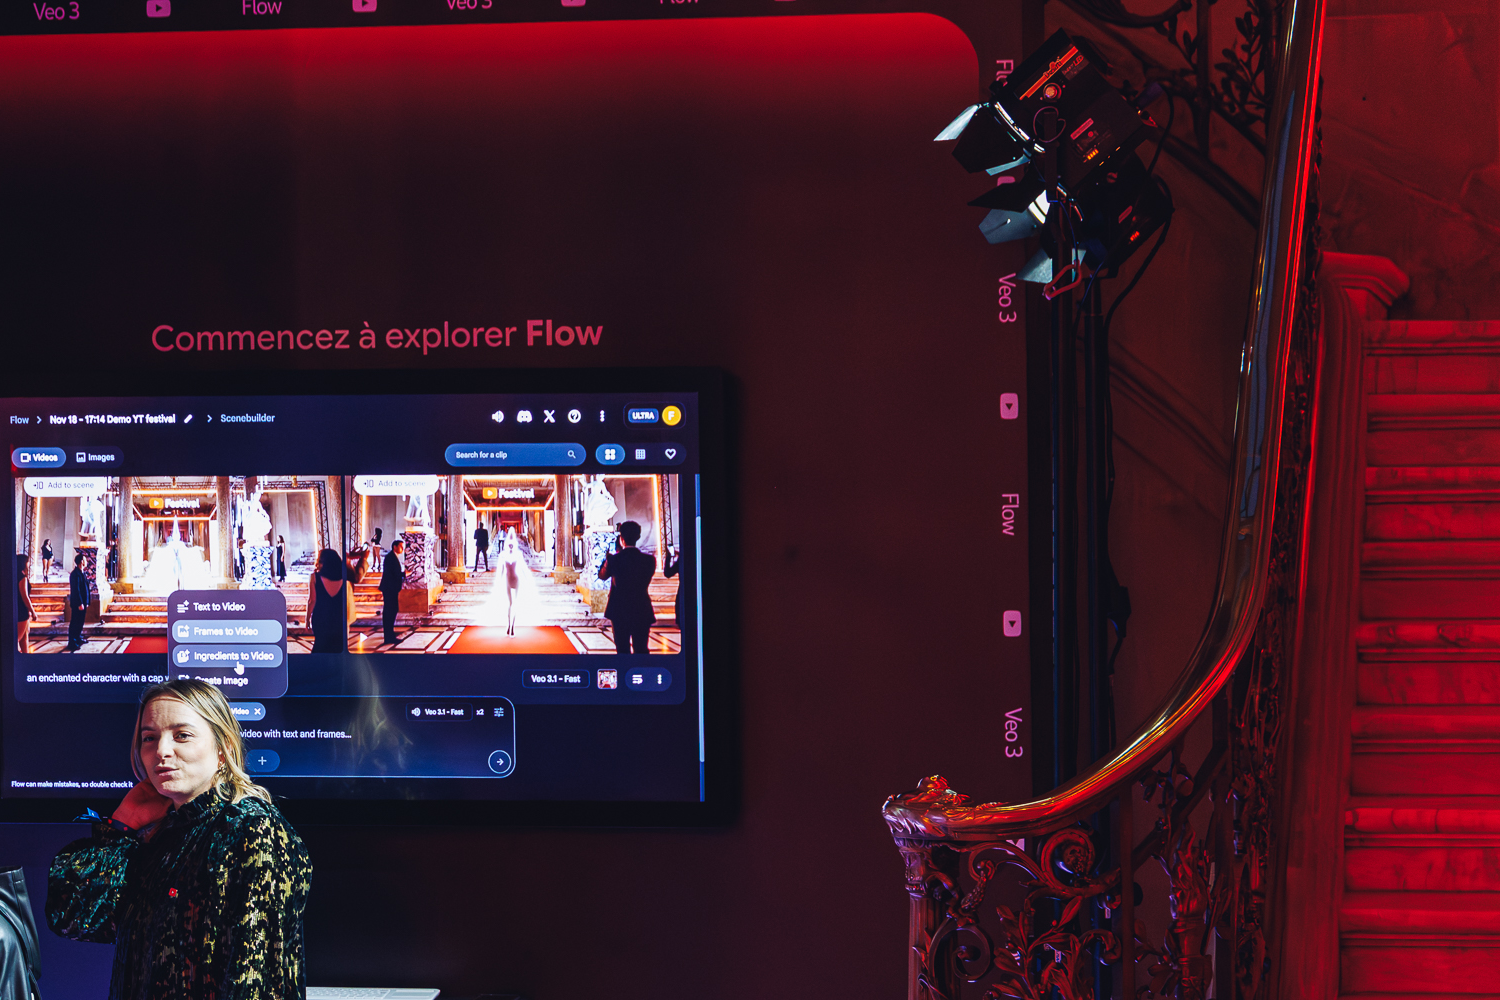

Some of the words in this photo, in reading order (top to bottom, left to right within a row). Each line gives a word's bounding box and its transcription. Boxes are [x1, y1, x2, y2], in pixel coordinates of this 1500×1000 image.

[33, 2, 65, 20] Veo
[69, 1, 80, 20] 3
[242, 0, 282, 15] Flow
[998, 273, 1017, 307] Veo
[998, 311, 1017, 323] 3
[152, 325, 349, 351] Commencez
[359, 321, 376, 349] à
[386, 321, 516, 355] explorer
[527, 319, 603, 346] Flow
[10, 416, 29, 425] Flow
[49, 415, 67, 424] Nov
[68, 415, 77, 424] 18
[85, 414, 105, 424] 17:14
[107, 414, 131, 424] Demo
[132, 414, 144, 423] YT
[145, 414, 176, 423] festival
[220, 414, 275, 423] Scenebuilder
[632, 412, 654, 421] ULTRA
[33, 454, 58, 462] Videos
[88, 454, 115, 463] Images
[456, 451, 478, 459] Search
[479, 451, 489, 459] for
[497, 451, 507, 460] clip
[499, 488, 535, 499] Festival
[165, 498, 200, 509] Festival
[1001, 493, 1019, 536] Flow
[193, 602, 211, 611] Text
[212, 602, 221, 611] to
[222, 602, 246, 611] Video
[194, 627, 224, 636] Frames
[225, 627, 234, 636] to
[235, 627, 259, 636] Video
[194, 652, 239, 662] Ingredients
[240, 652, 249, 660] to
[251, 651, 274, 660] Video
[27, 674, 37, 682] an
[39, 673, 81, 682] enchanted
[82, 674, 121, 682] character
[122, 673, 140, 682] with
[148, 675, 163, 685] cap
[223, 676, 249, 687] Image
[531, 675, 546, 683] Veo
[564, 675, 581, 683] Fast
[425, 709, 436, 717] Veo
[451, 708, 464, 716] Fast
[1004, 708, 1023, 742] Veo
[240, 730, 262, 738] video
[264, 729, 280, 739] with
[282, 730, 298, 739] text
[300, 729, 315, 739] and
[317, 729, 352, 739] frames...
[1004, 745, 1023, 758] 3
[54, 781, 81, 789] mistakes,
